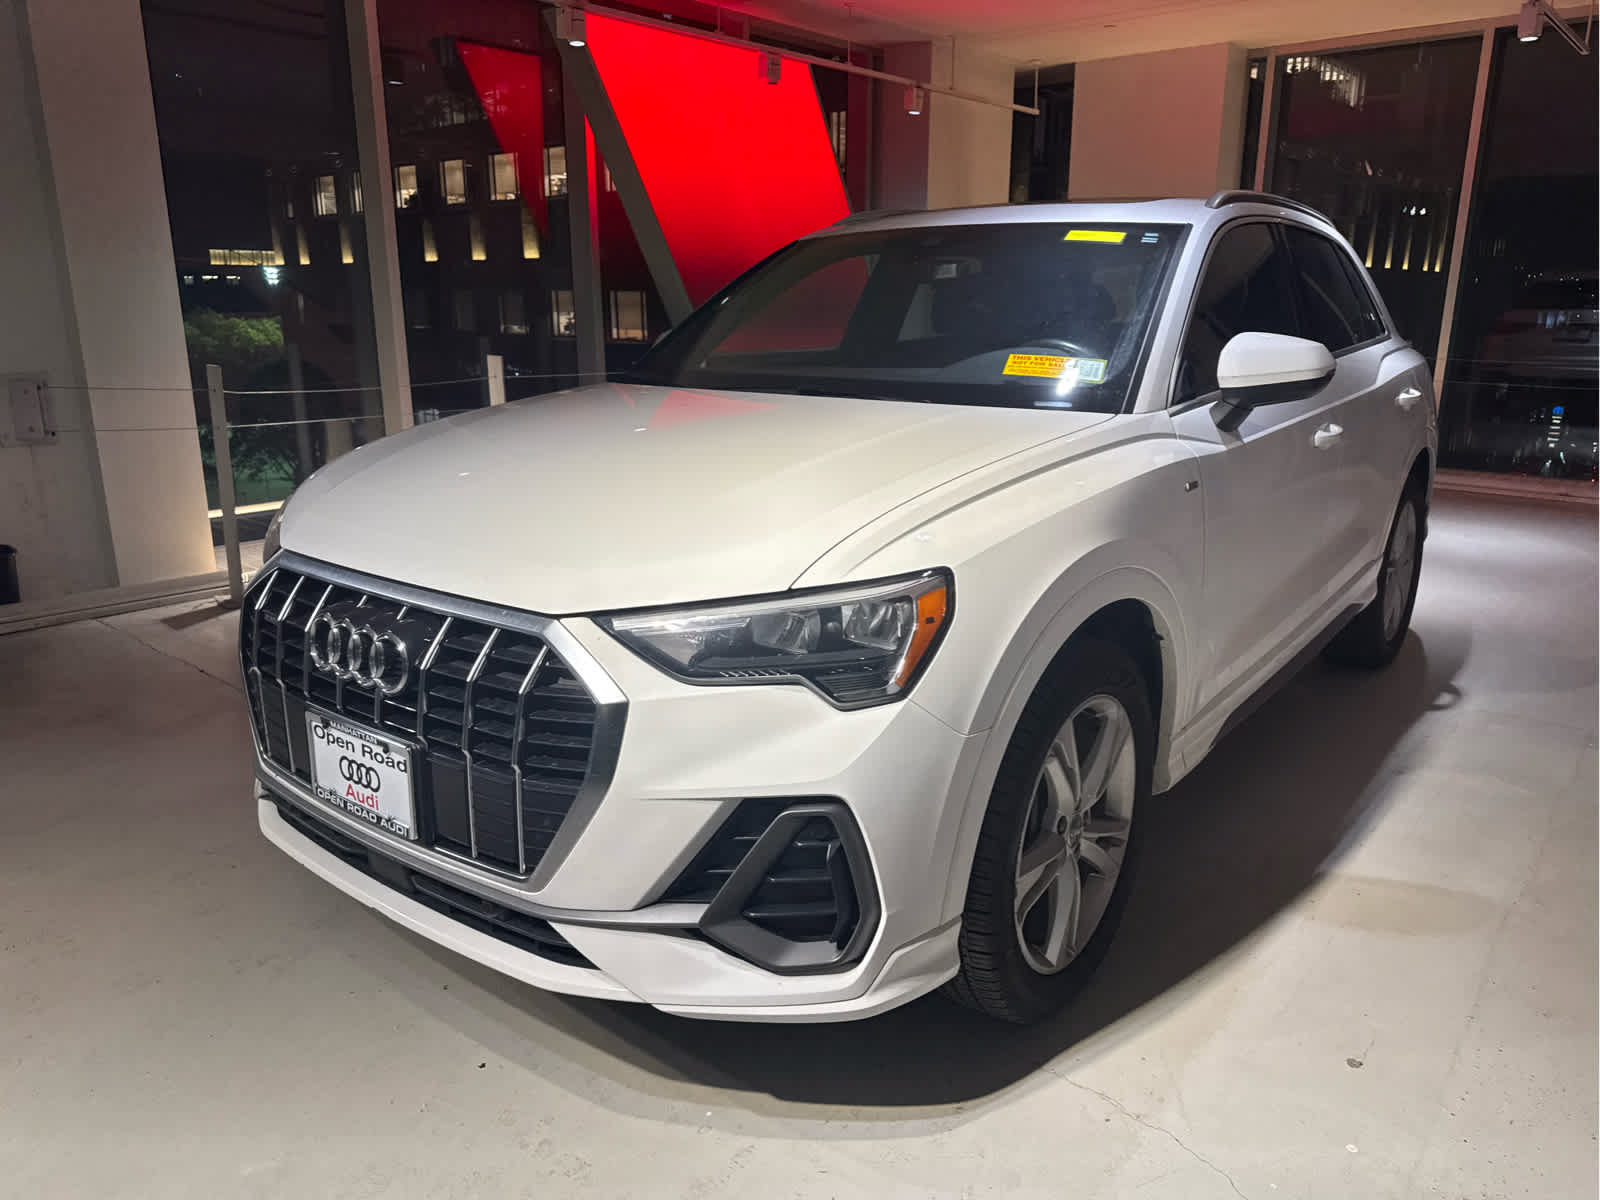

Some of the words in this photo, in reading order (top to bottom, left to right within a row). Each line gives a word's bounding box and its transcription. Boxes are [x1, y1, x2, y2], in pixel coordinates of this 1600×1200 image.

[313, 724, 355, 753] Open
[361, 743, 408, 773] Road
[317, 788, 344, 808] OPEN
[346, 802, 377, 823] ROAD
[380, 819, 408, 838] AUDI
[345, 783, 379, 811] Audi
